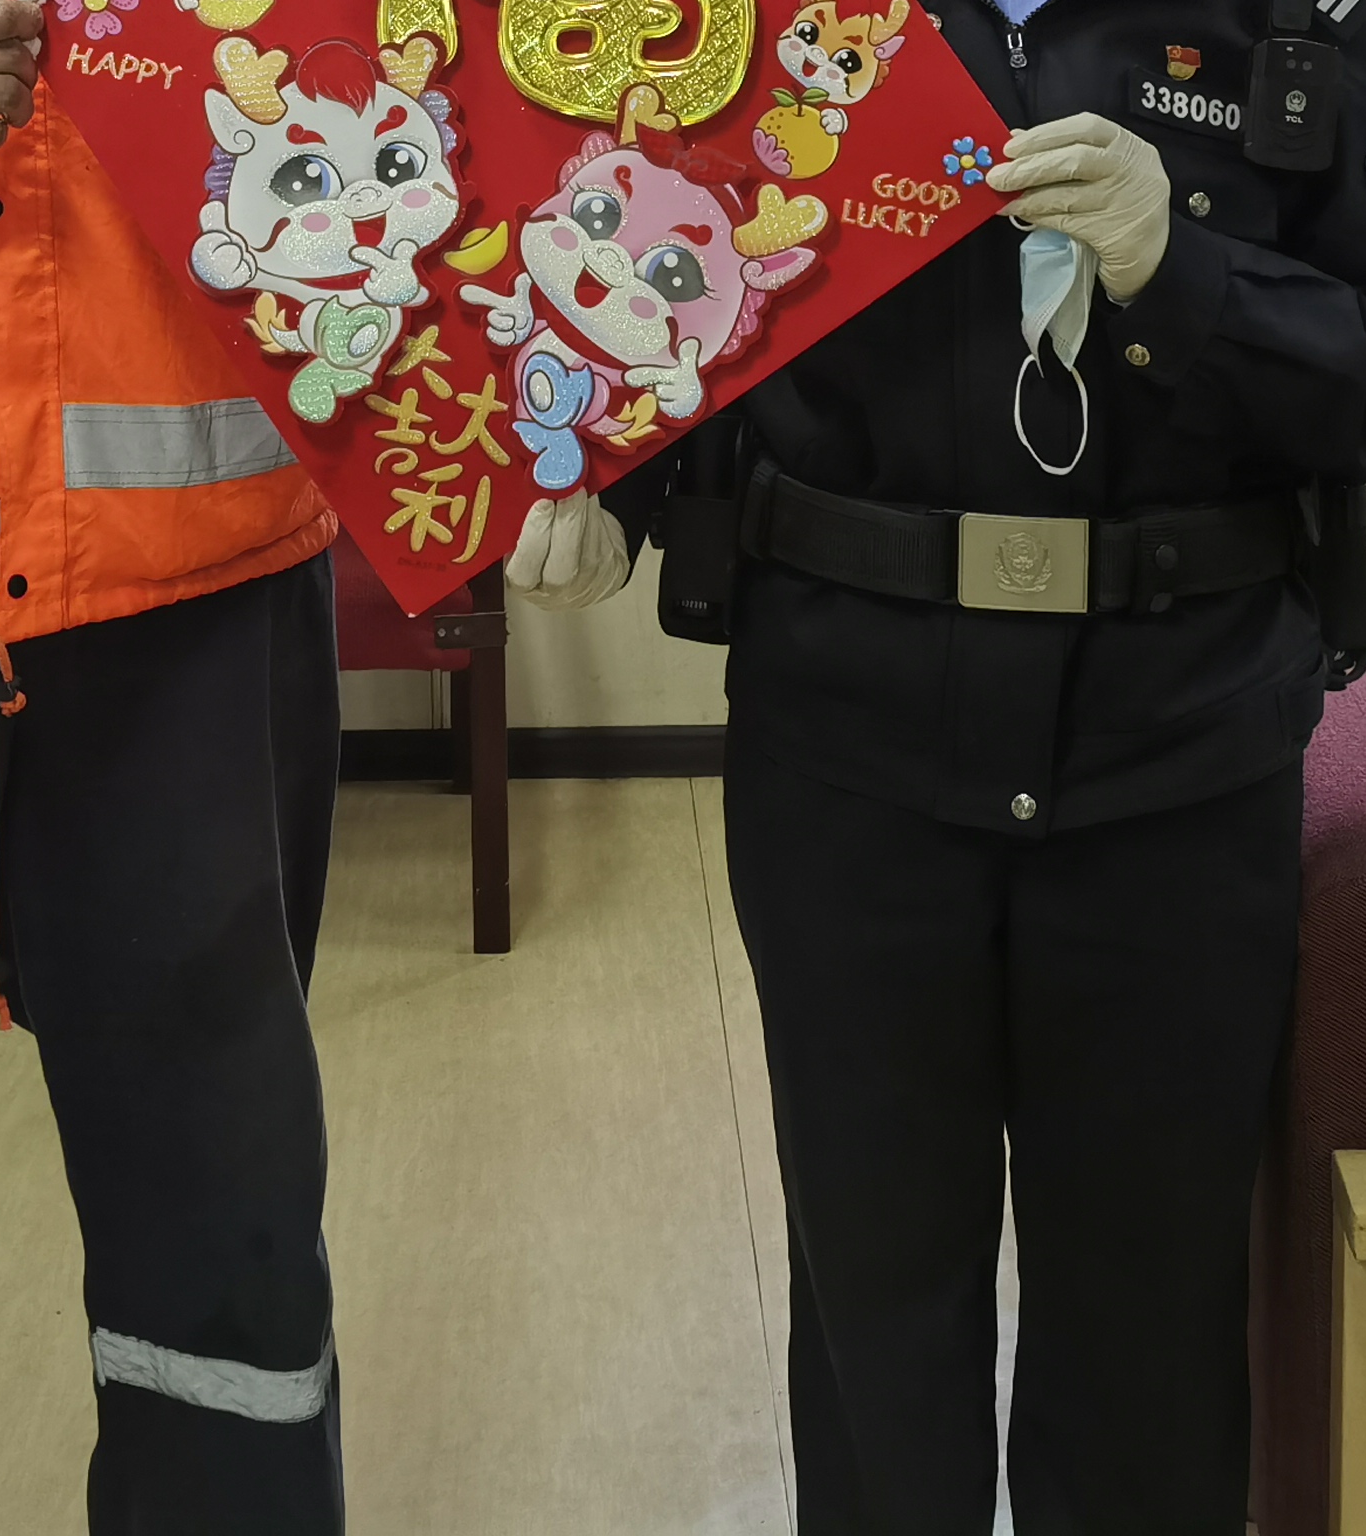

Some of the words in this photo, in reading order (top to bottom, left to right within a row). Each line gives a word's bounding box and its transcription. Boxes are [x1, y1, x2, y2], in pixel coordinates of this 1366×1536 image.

[66, 42, 183, 90] HAPPY
[1140, 81, 1241, 131] 338060
[1285, 115, 1304, 124] TCL
[872, 172, 961, 212] GOOD
[840, 197, 938, 237] LUCKY
